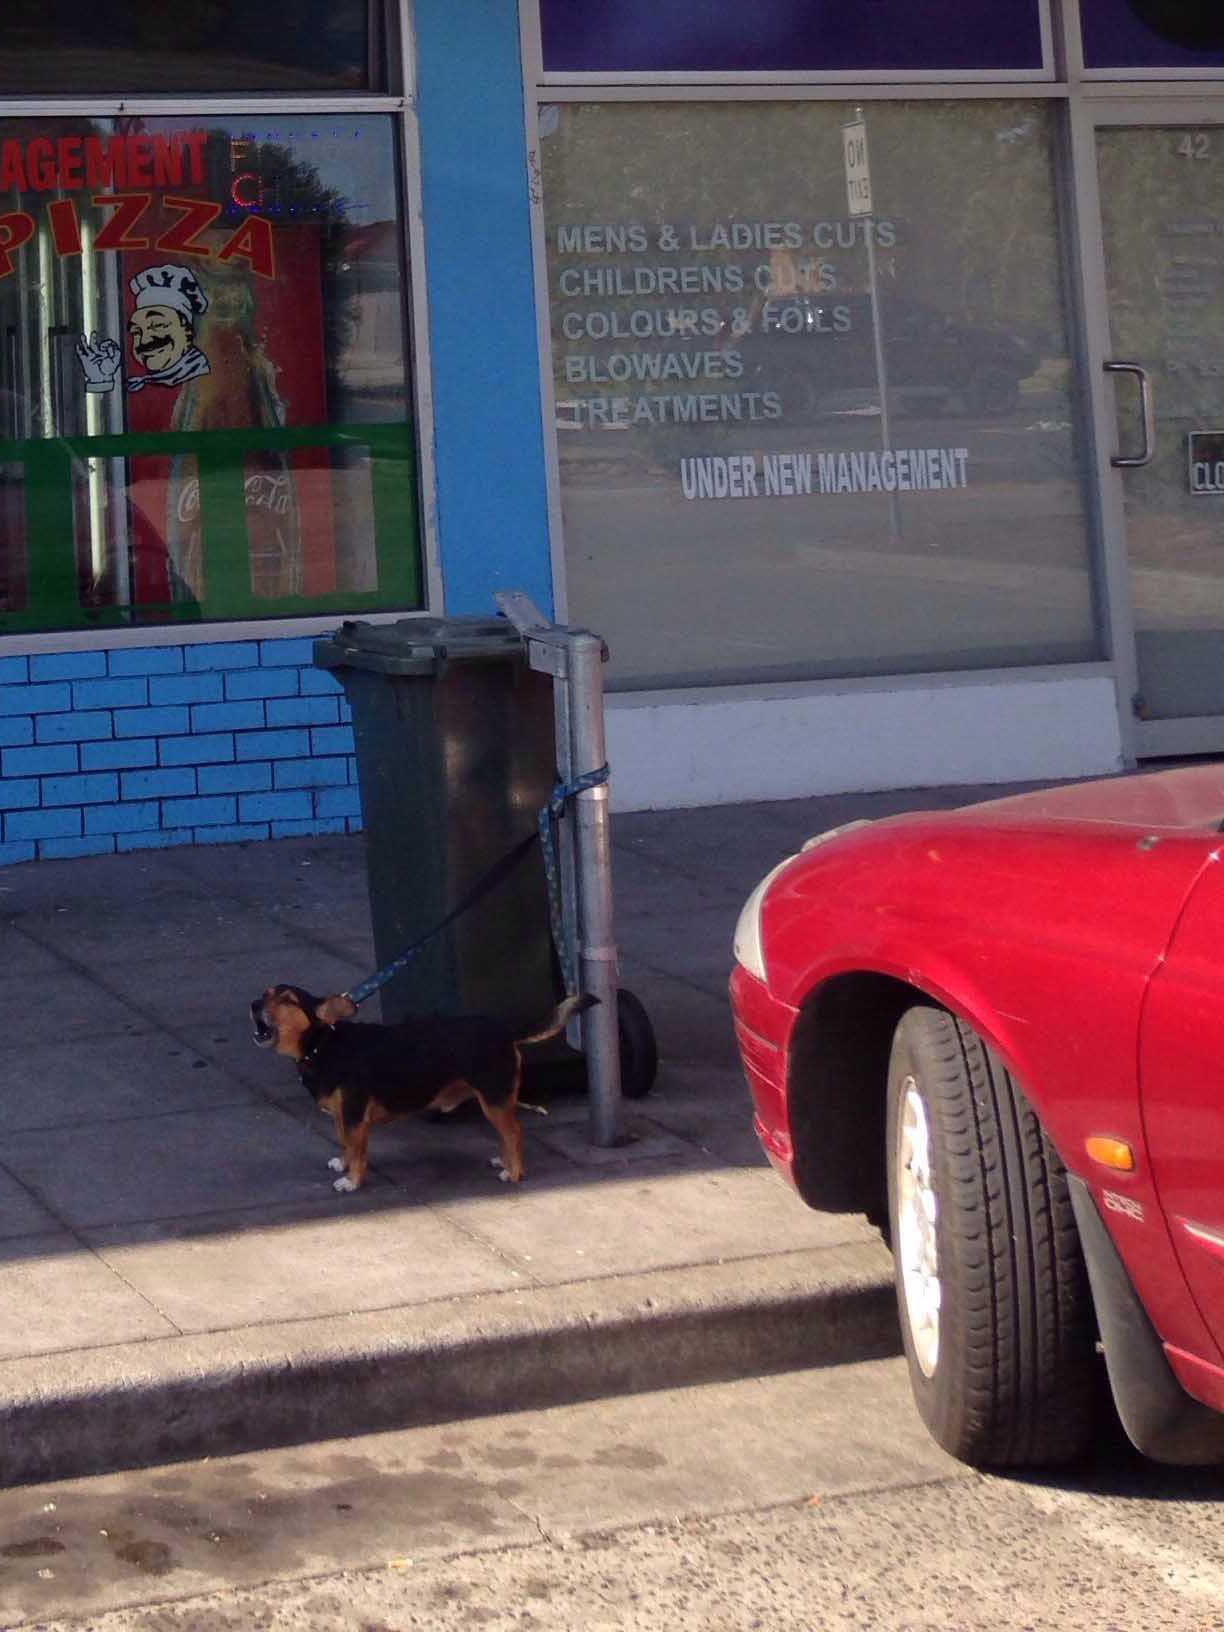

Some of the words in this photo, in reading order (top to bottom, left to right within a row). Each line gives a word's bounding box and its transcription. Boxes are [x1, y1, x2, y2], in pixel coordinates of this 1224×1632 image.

[1177, 133, 1209, 159] 42
[557, 225, 648, 253] MENS
[658, 224, 680, 253] &
[690, 222, 803, 250] LADIES
[813, 220, 896, 249] CUTS
[559, 265, 744, 297] CHILDRENS
[754, 262, 837, 293] CUTS
[562, 308, 721, 340] COLOURS
[731, 306, 753, 336] &
[762, 305, 852, 335] FOILS
[565, 351, 744, 384] BLOWAVES
[571, 391, 783, 426] TREATMENTS
[680, 455, 759, 500] UNDER
[762, 452, 812, 496] NEW
[817, 447, 969, 494] MANAGEMENT
